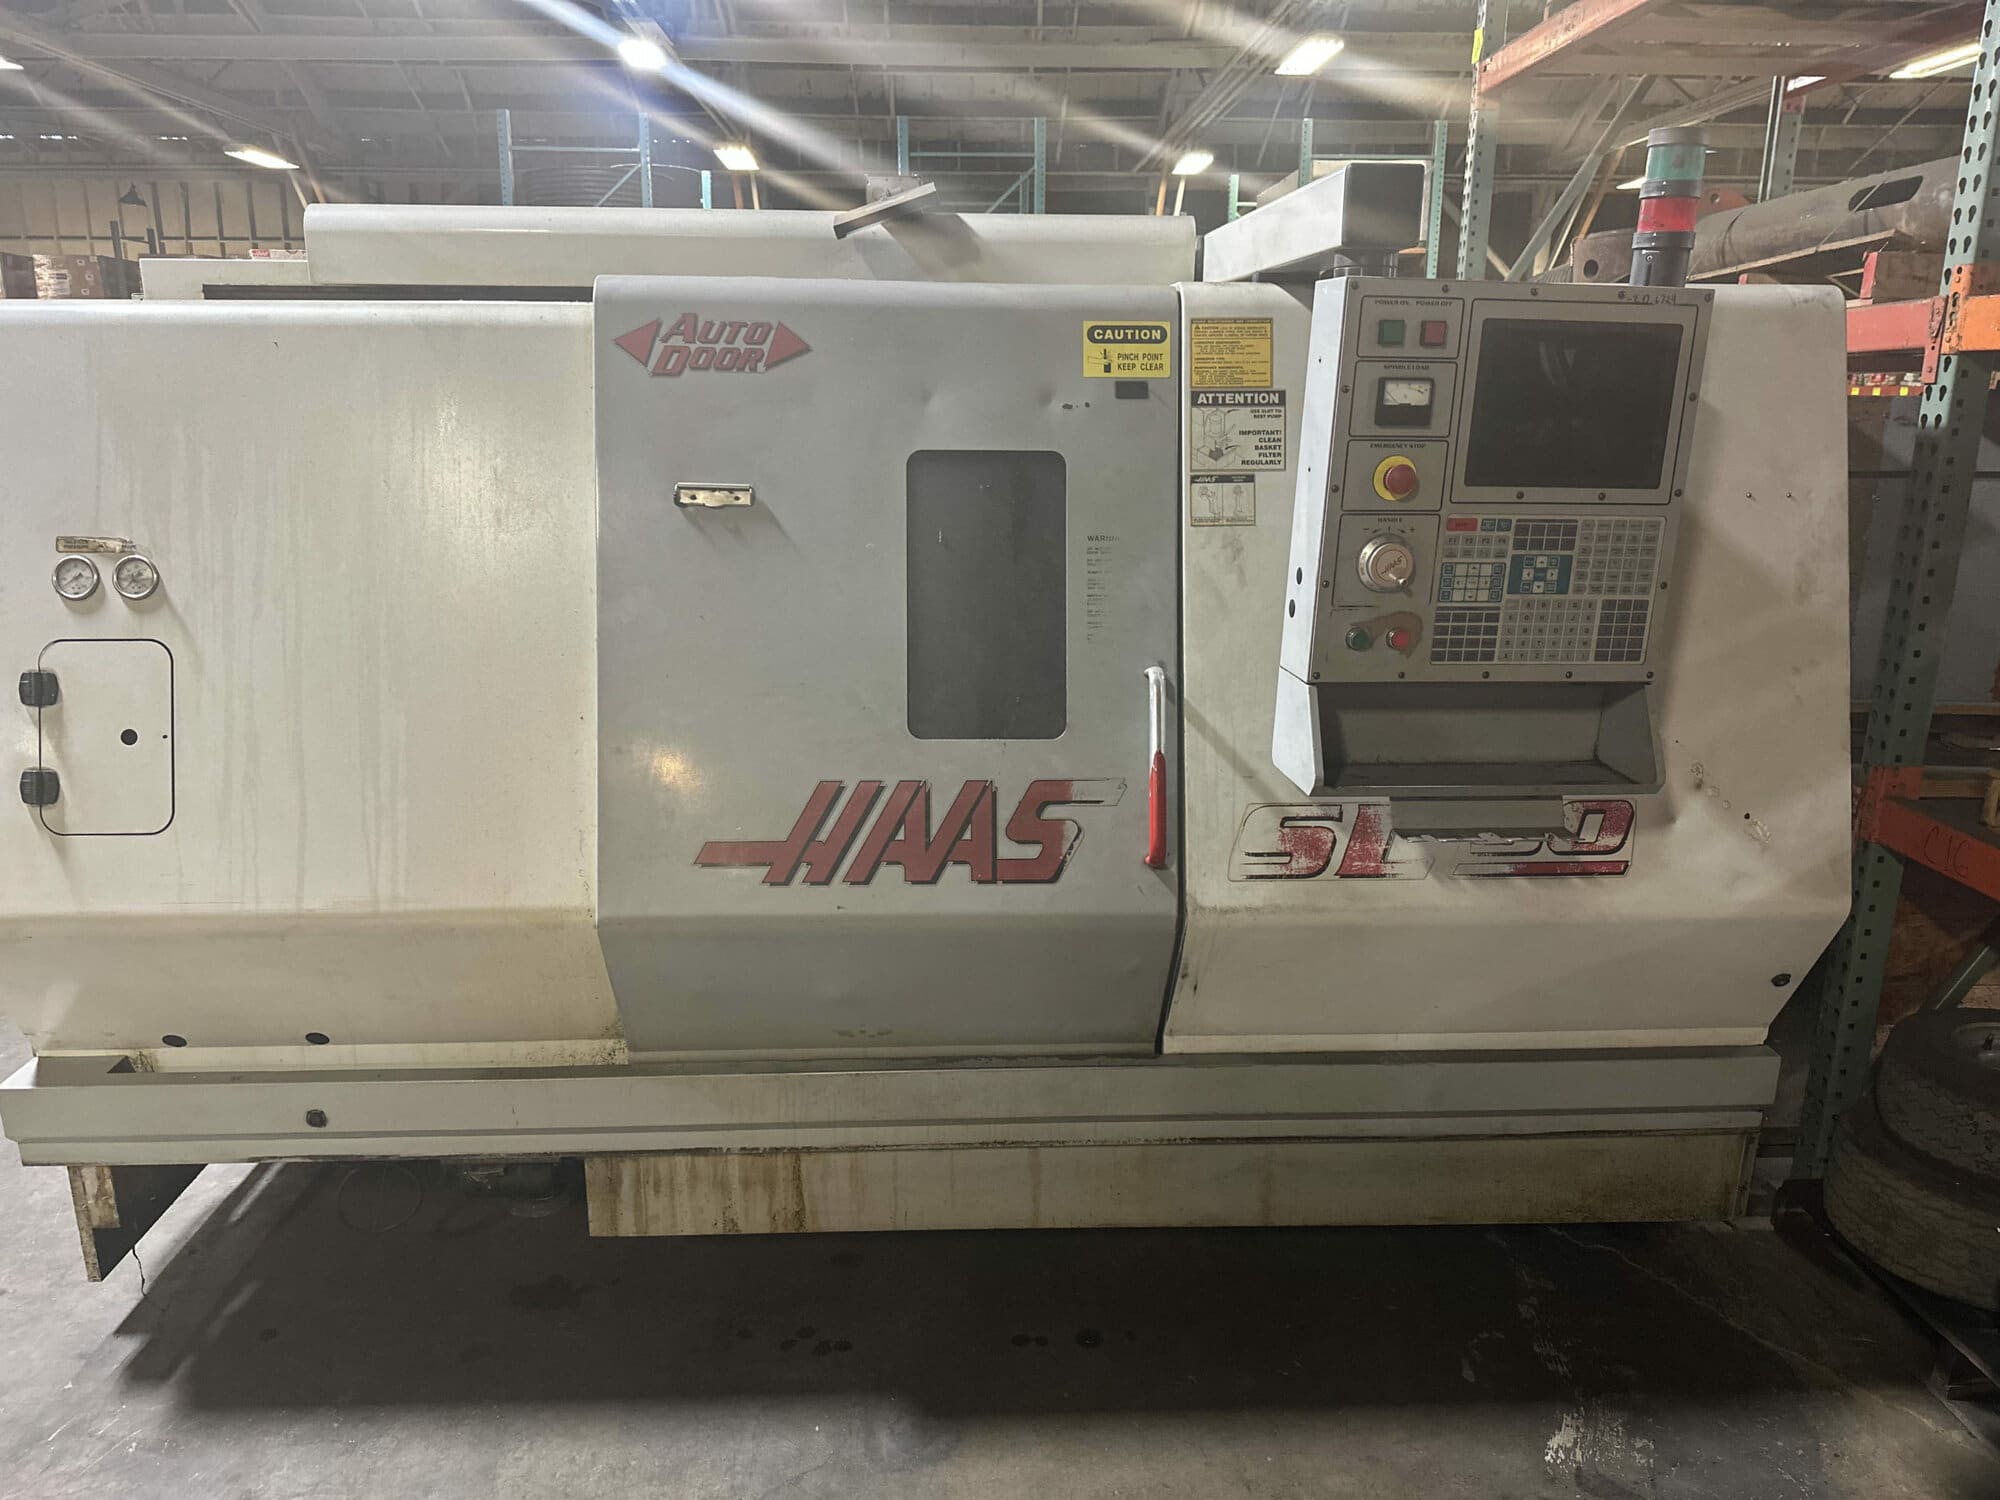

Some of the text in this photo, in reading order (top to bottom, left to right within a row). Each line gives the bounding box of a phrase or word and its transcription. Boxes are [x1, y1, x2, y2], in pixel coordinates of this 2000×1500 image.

[659, 312, 773, 346] AUTO
[1093, 329, 1161, 340] CAUTION
[651, 345, 765, 376] DOOR
[1142, 353, 1164, 361] POINT
[1117, 363, 1164, 371] KEEP CLEAR
[1197, 392, 1280, 404] ATTENTION
[694, 780, 1127, 886] HAAS
